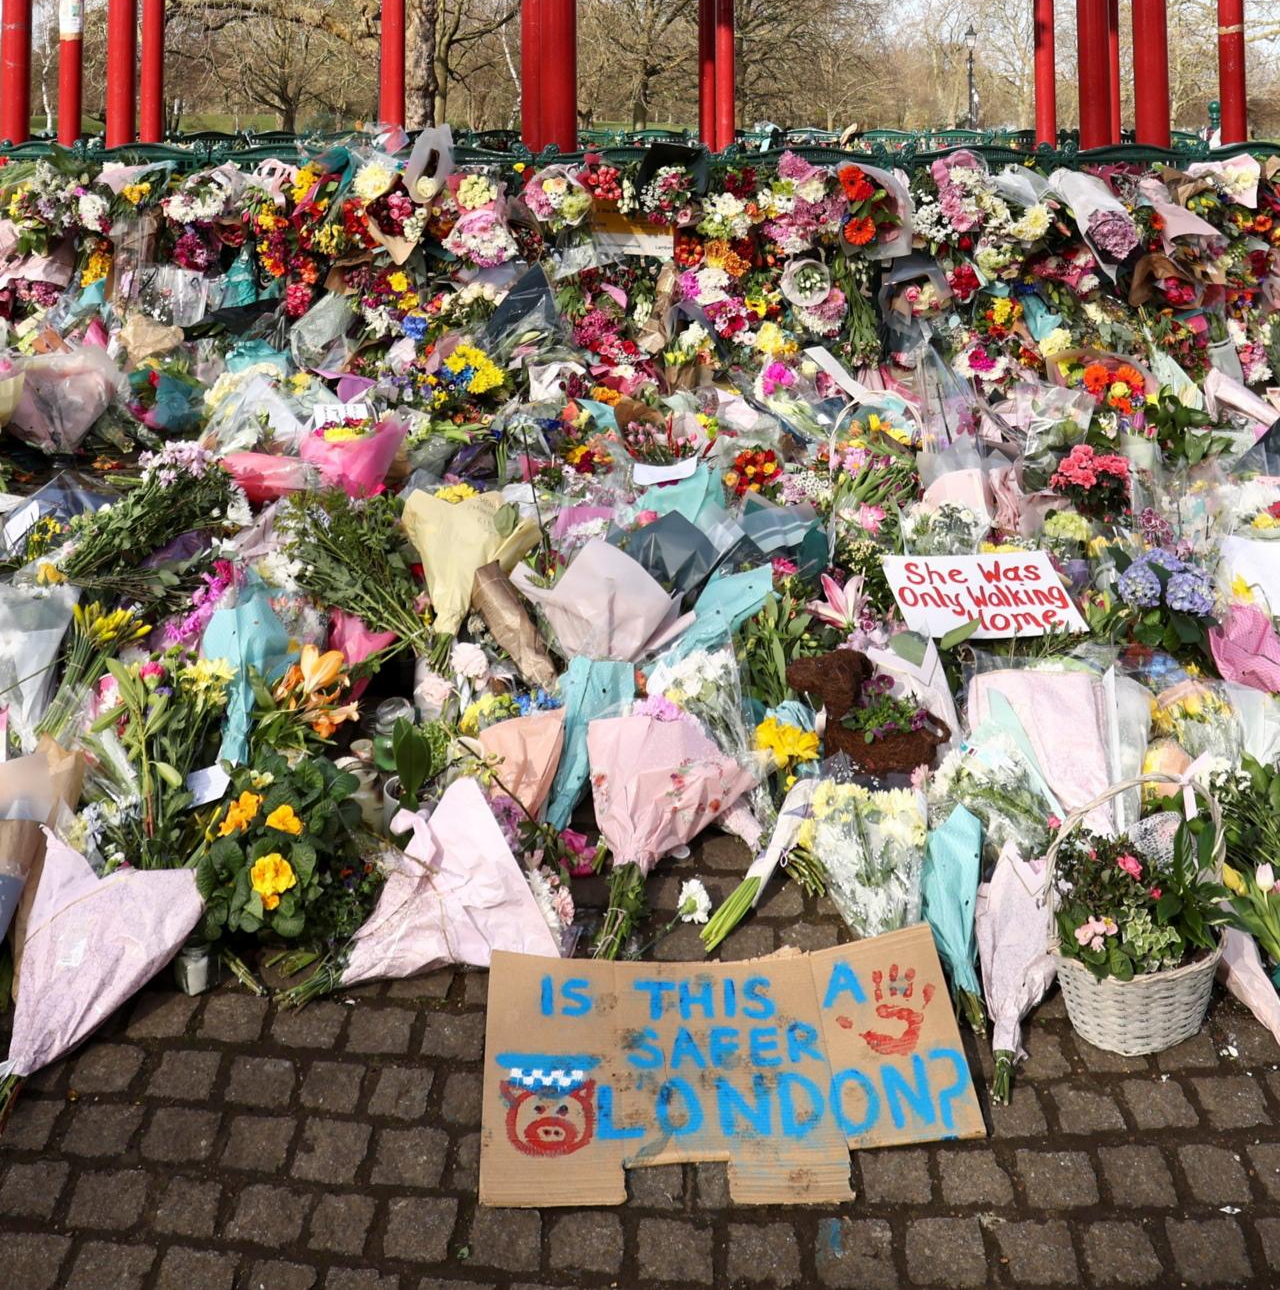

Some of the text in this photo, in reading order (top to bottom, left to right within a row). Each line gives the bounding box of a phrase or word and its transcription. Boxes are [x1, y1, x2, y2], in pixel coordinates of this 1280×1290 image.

[904, 560, 1041, 585] She Was
[898, 583, 1070, 616] Only Walking
[540, 961, 867, 1020] IS THIS A
[627, 1020, 825, 1071] SAFER
[596, 1046, 971, 1140] LONDON?
